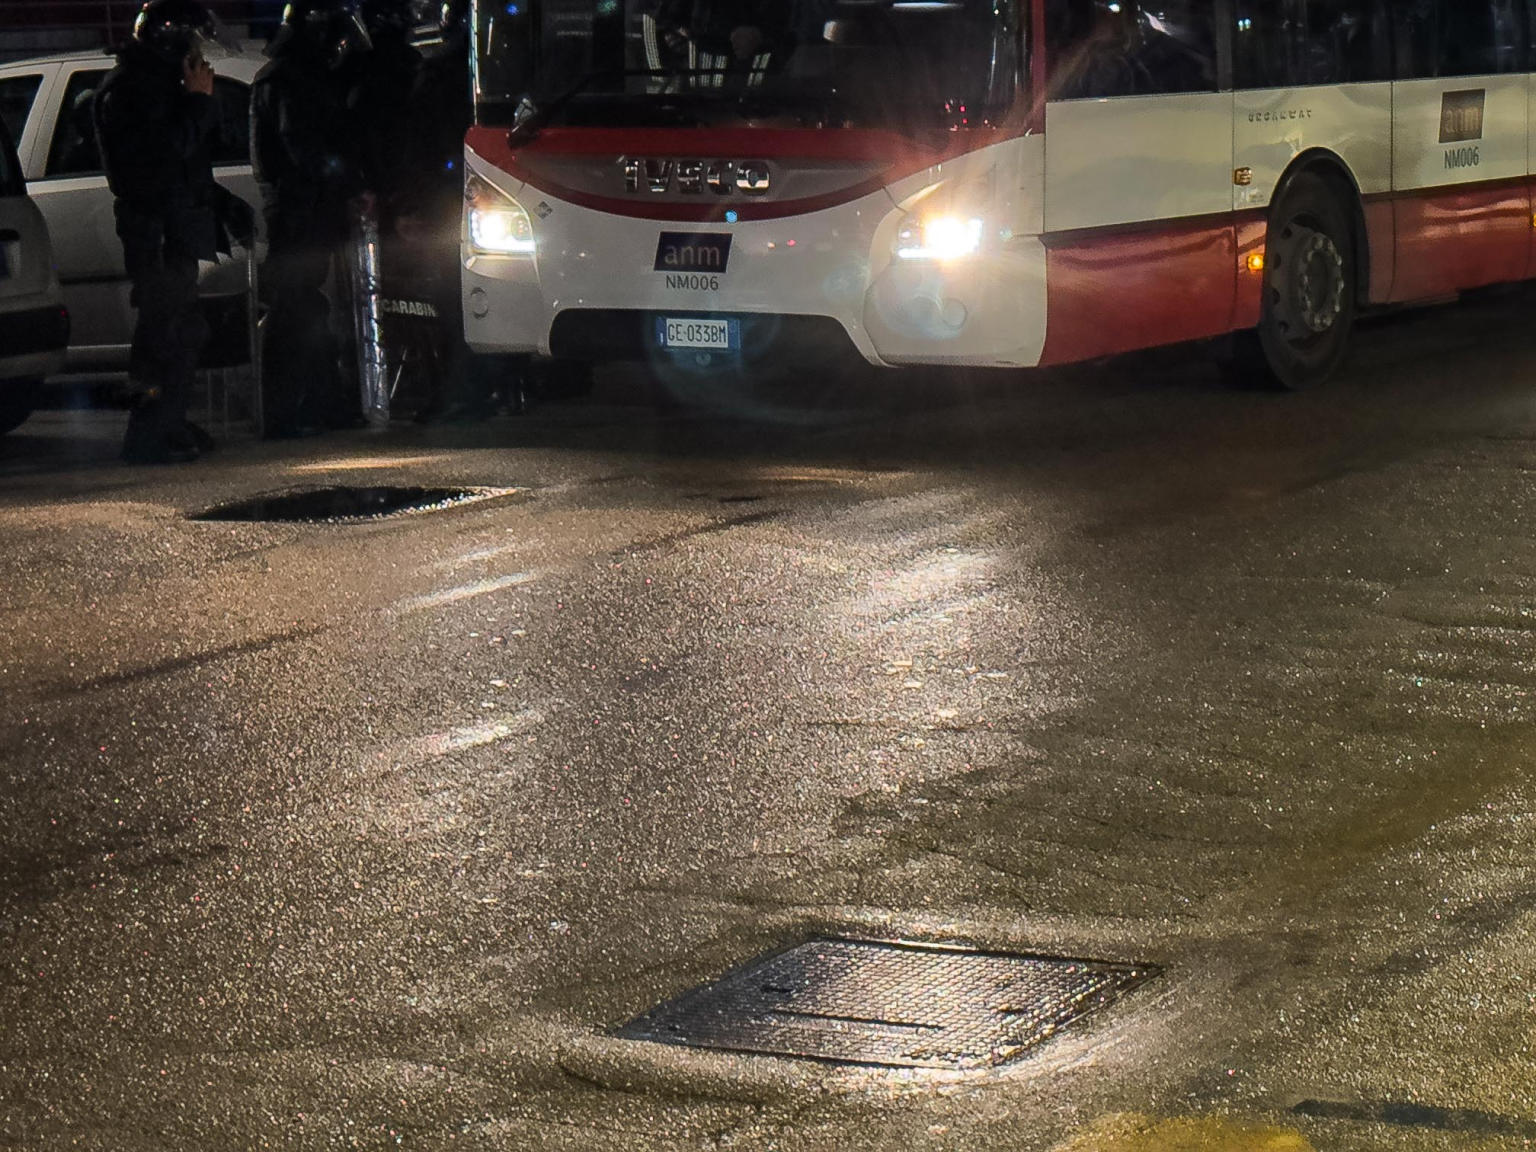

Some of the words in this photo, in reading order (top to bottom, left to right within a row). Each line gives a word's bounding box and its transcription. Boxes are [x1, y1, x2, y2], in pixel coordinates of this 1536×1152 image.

[1444, 147, 1480, 169] NM006
[624, 159, 770, 196] IVECO
[664, 244, 720, 266] anm
[665, 275, 719, 291] NM006
[381, 298, 440, 318] CARABIN
